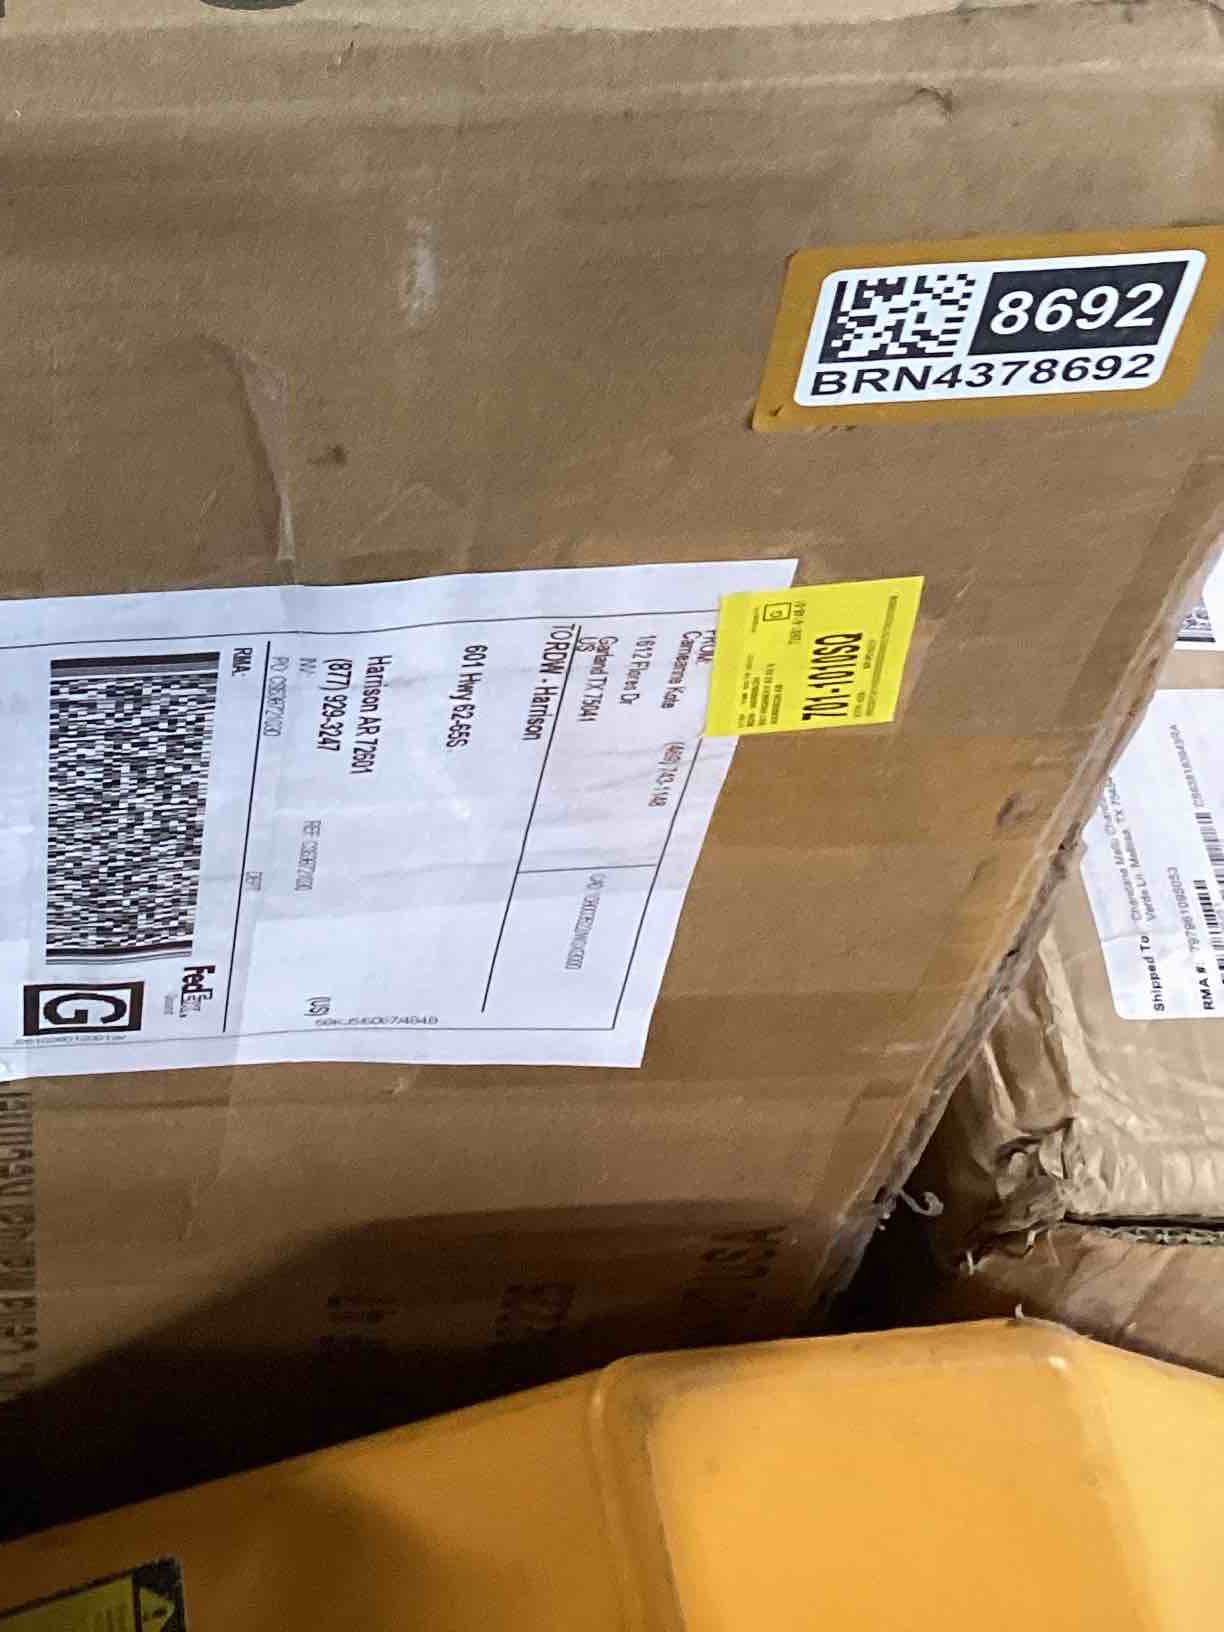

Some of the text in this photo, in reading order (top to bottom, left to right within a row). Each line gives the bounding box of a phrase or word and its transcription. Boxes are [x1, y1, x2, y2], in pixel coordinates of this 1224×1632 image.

[989, 282, 1165, 336] 8692
[810, 353, 1156, 397] BRN4378692
[590, 635, 618, 675] Garland
[802, 632, 864, 721] 701-1010SQ
[316, 658, 353, 752] (877) 929-3247
[446, 644, 487, 749] 601 Hwy 62-65S
[584, 676, 608, 691] TX
[351, 654, 392, 775] Harrison AR 72601
[522, 685, 555, 741] Harrison
[1139, 935, 1166, 1012] Shipped To
[1200, 977, 1216, 1011] RMA
[44, 994, 126, 1025] G
